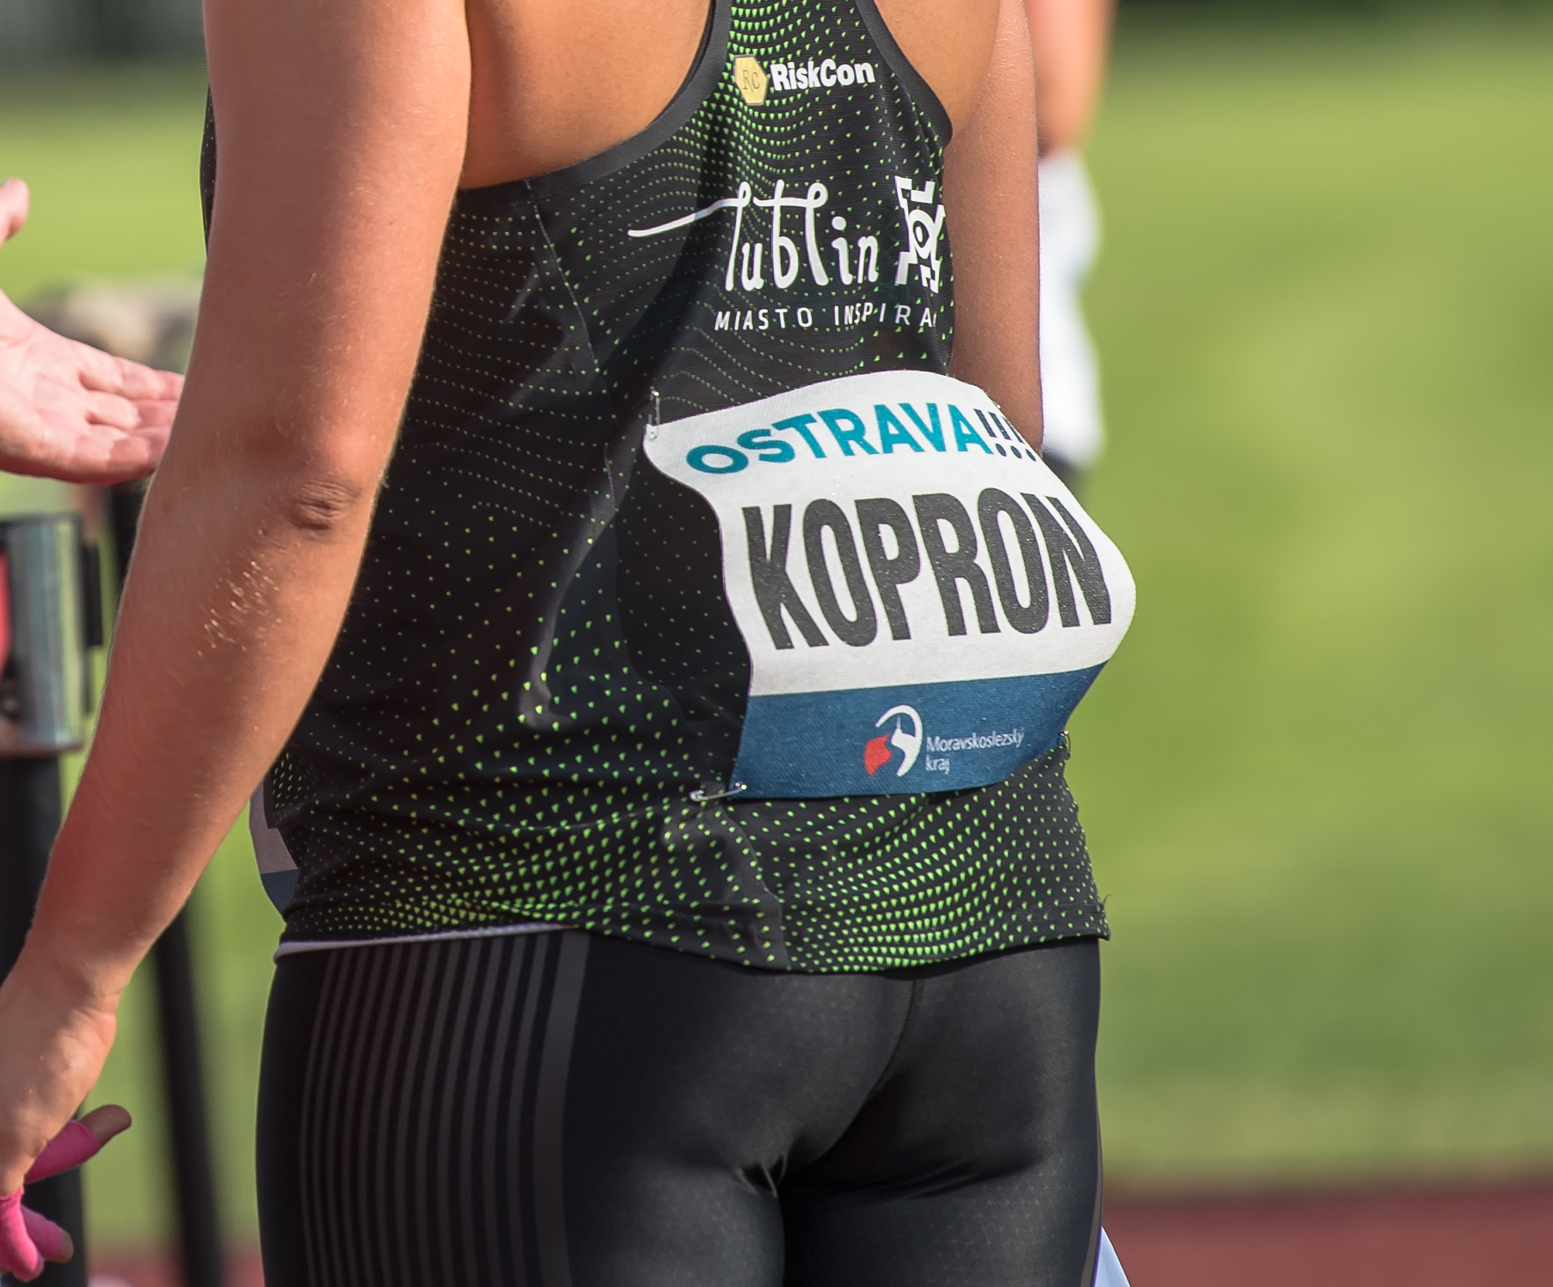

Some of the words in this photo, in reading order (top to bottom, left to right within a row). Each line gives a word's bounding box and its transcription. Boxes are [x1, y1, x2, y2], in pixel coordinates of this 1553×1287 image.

[770, 58, 876, 91] RiskCon
[714, 306, 813, 331] MIASTO
[741, 487, 1113, 651] KOPRON
[925, 753, 950, 775] kraj
